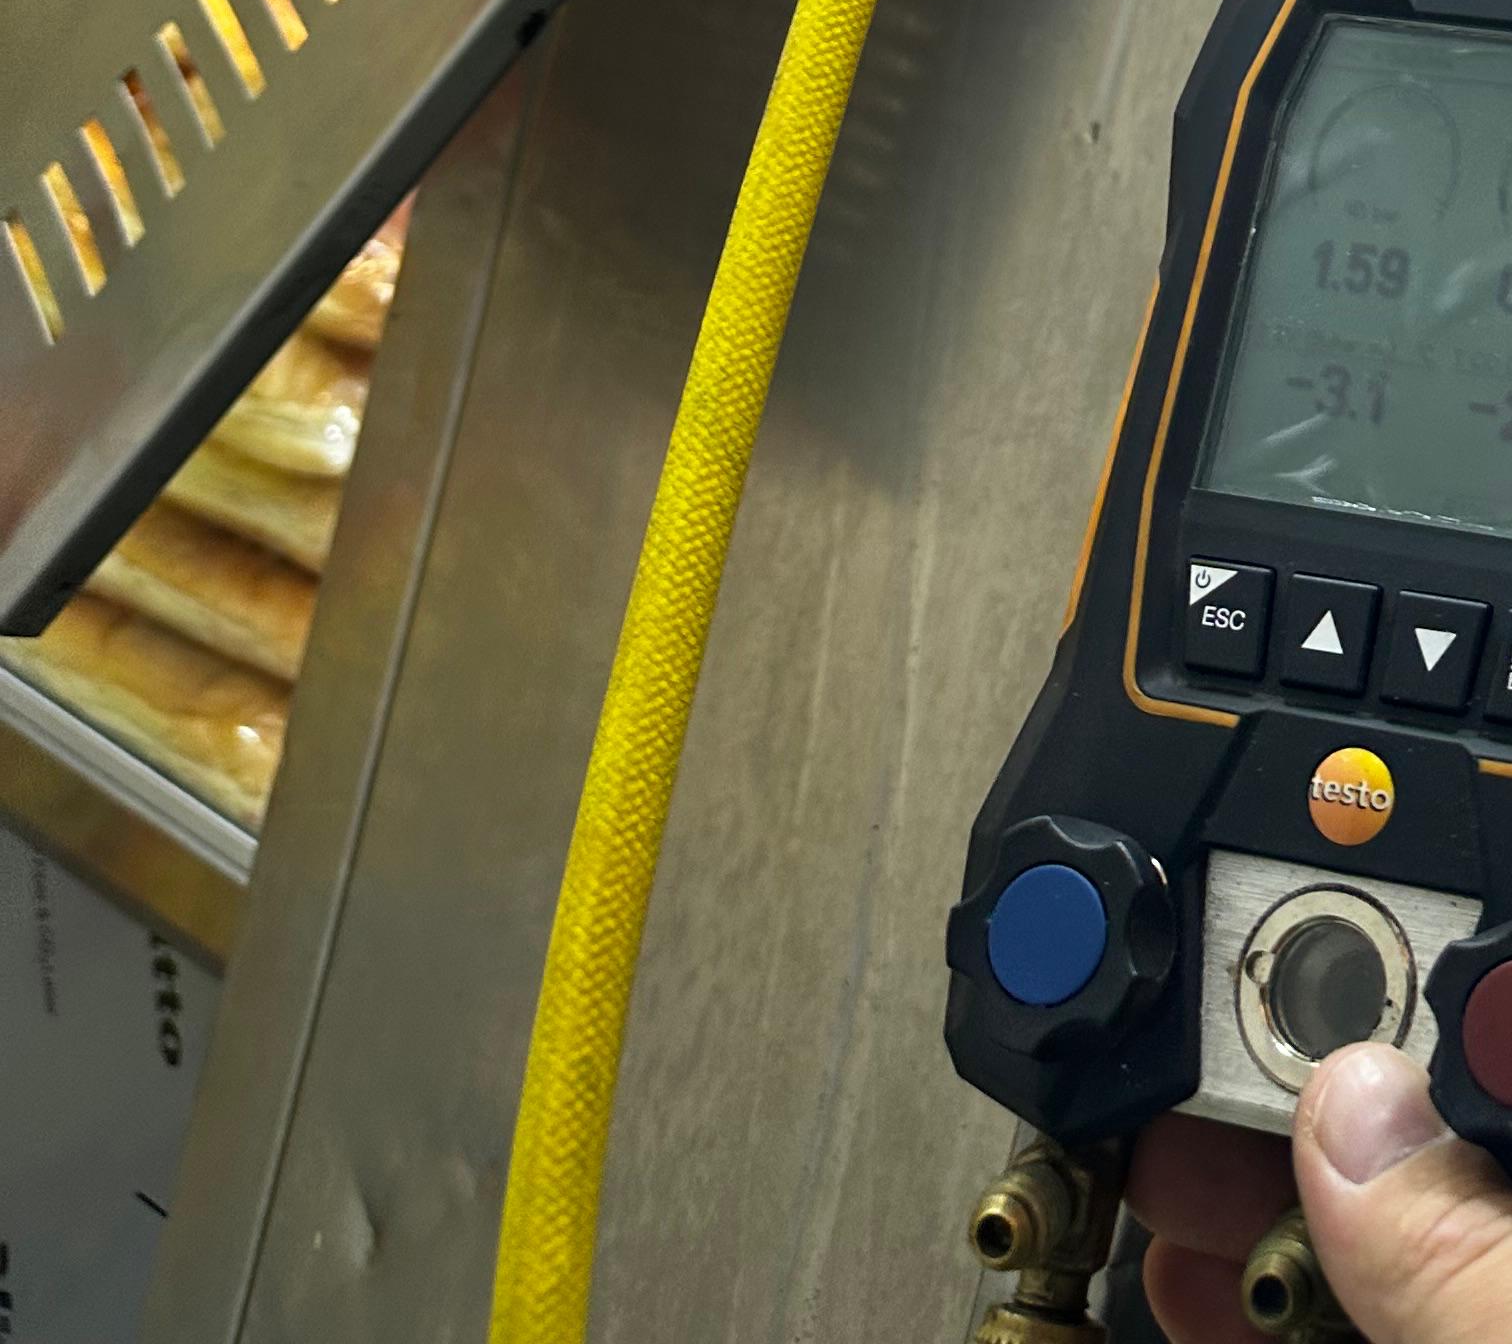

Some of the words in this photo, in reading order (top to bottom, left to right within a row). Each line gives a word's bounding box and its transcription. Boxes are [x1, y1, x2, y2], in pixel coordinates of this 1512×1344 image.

[1311, 238, 1412, 301] 1.59
[1285, 363, 1392, 429] -3.1
[1201, 605, 1247, 631] ESC
[1310, 773, 1394, 812] testo
